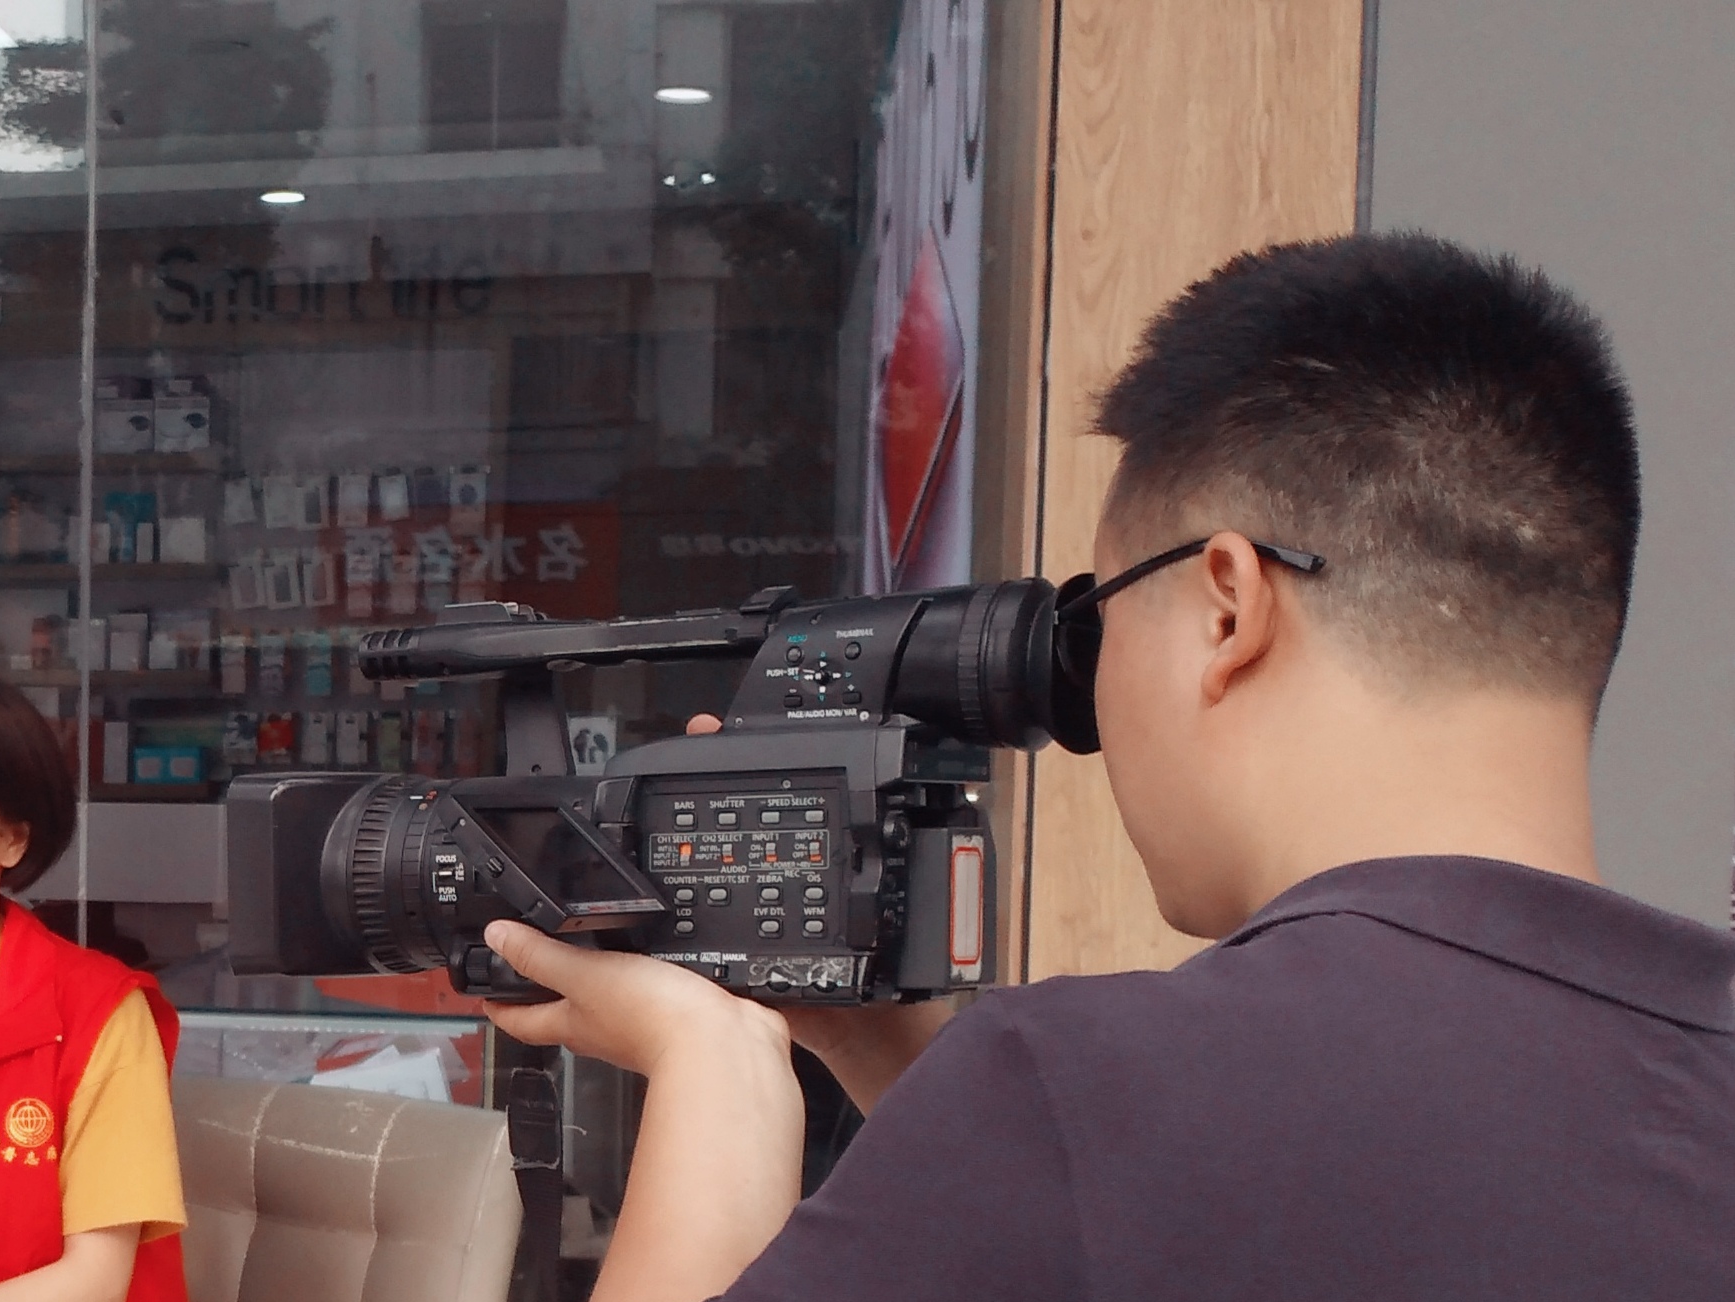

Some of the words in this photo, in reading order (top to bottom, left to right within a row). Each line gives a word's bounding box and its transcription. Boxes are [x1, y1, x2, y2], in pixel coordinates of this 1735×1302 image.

[674, 801, 696, 810] BARS
[709, 799, 745, 809] SHUTTER
[672, 834, 697, 843] SELECT
[717, 833, 743, 842] SELECT
[752, 833, 774, 842] INPUT
[795, 832, 817, 840] INPUT
[435, 855, 457, 863] FOCUS
[720, 865, 747, 874] AUDIO
[784, 869, 801, 878] REC
[737, 875, 750, 884] SET
[756, 874, 783, 883] ZEBRA
[806, 873, 822, 883] OIS
[438, 886, 456, 894] PUSH
[438, 894, 457, 902] AUTO
[676, 908, 692, 916] LCD
[753, 907, 769, 916] EVF
[770, 907, 786, 916] DTL
[803, 907, 825, 916] WFM
[722, 953, 748, 962] MANUAL
